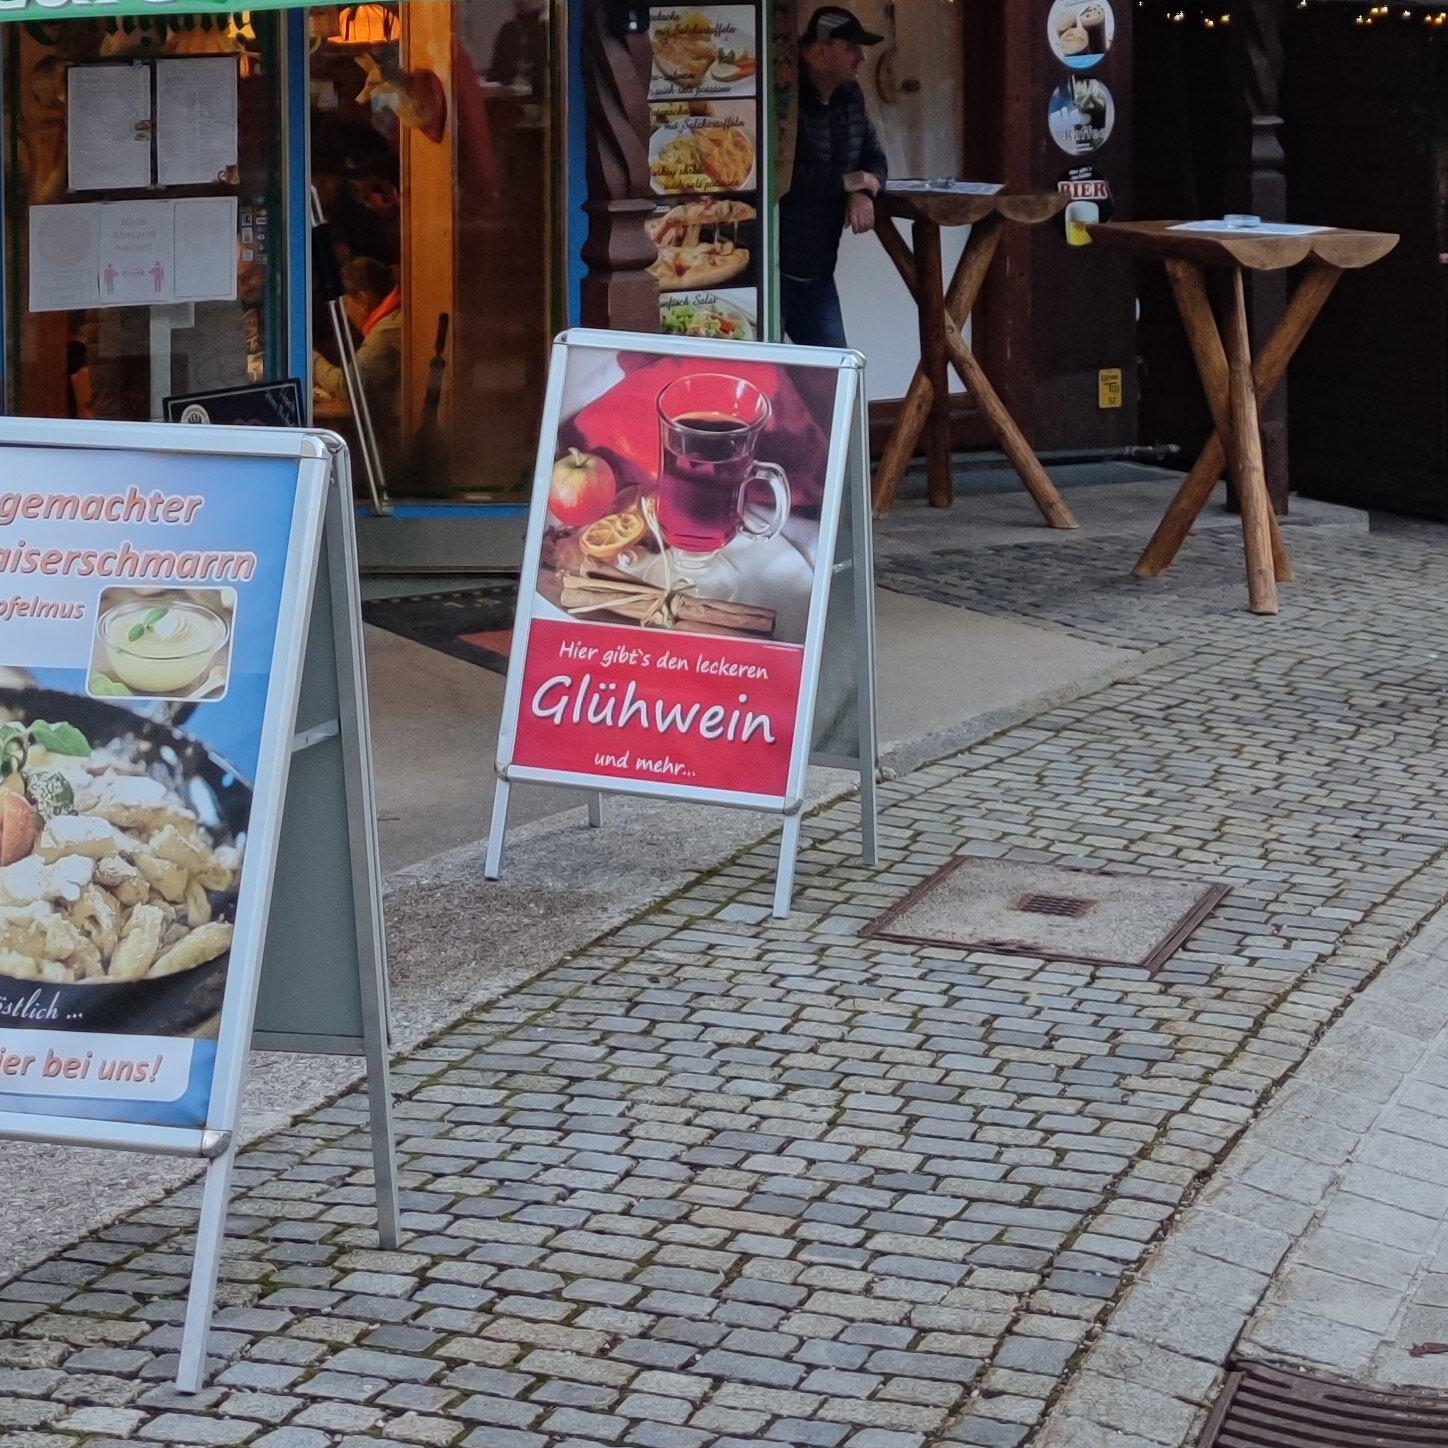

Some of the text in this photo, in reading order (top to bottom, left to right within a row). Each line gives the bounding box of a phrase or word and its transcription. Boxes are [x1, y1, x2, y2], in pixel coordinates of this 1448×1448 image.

[1059, 182, 1107, 199] BIER
[558, 640, 598, 662] Hier
[656, 649, 689, 672] den
[696, 654, 769, 681] leckeren
[530, 673, 777, 746] Glühwein
[594, 751, 629, 771] und
[42, 1049, 93, 1083] bei
[97, 1054, 164, 1085] uns!
